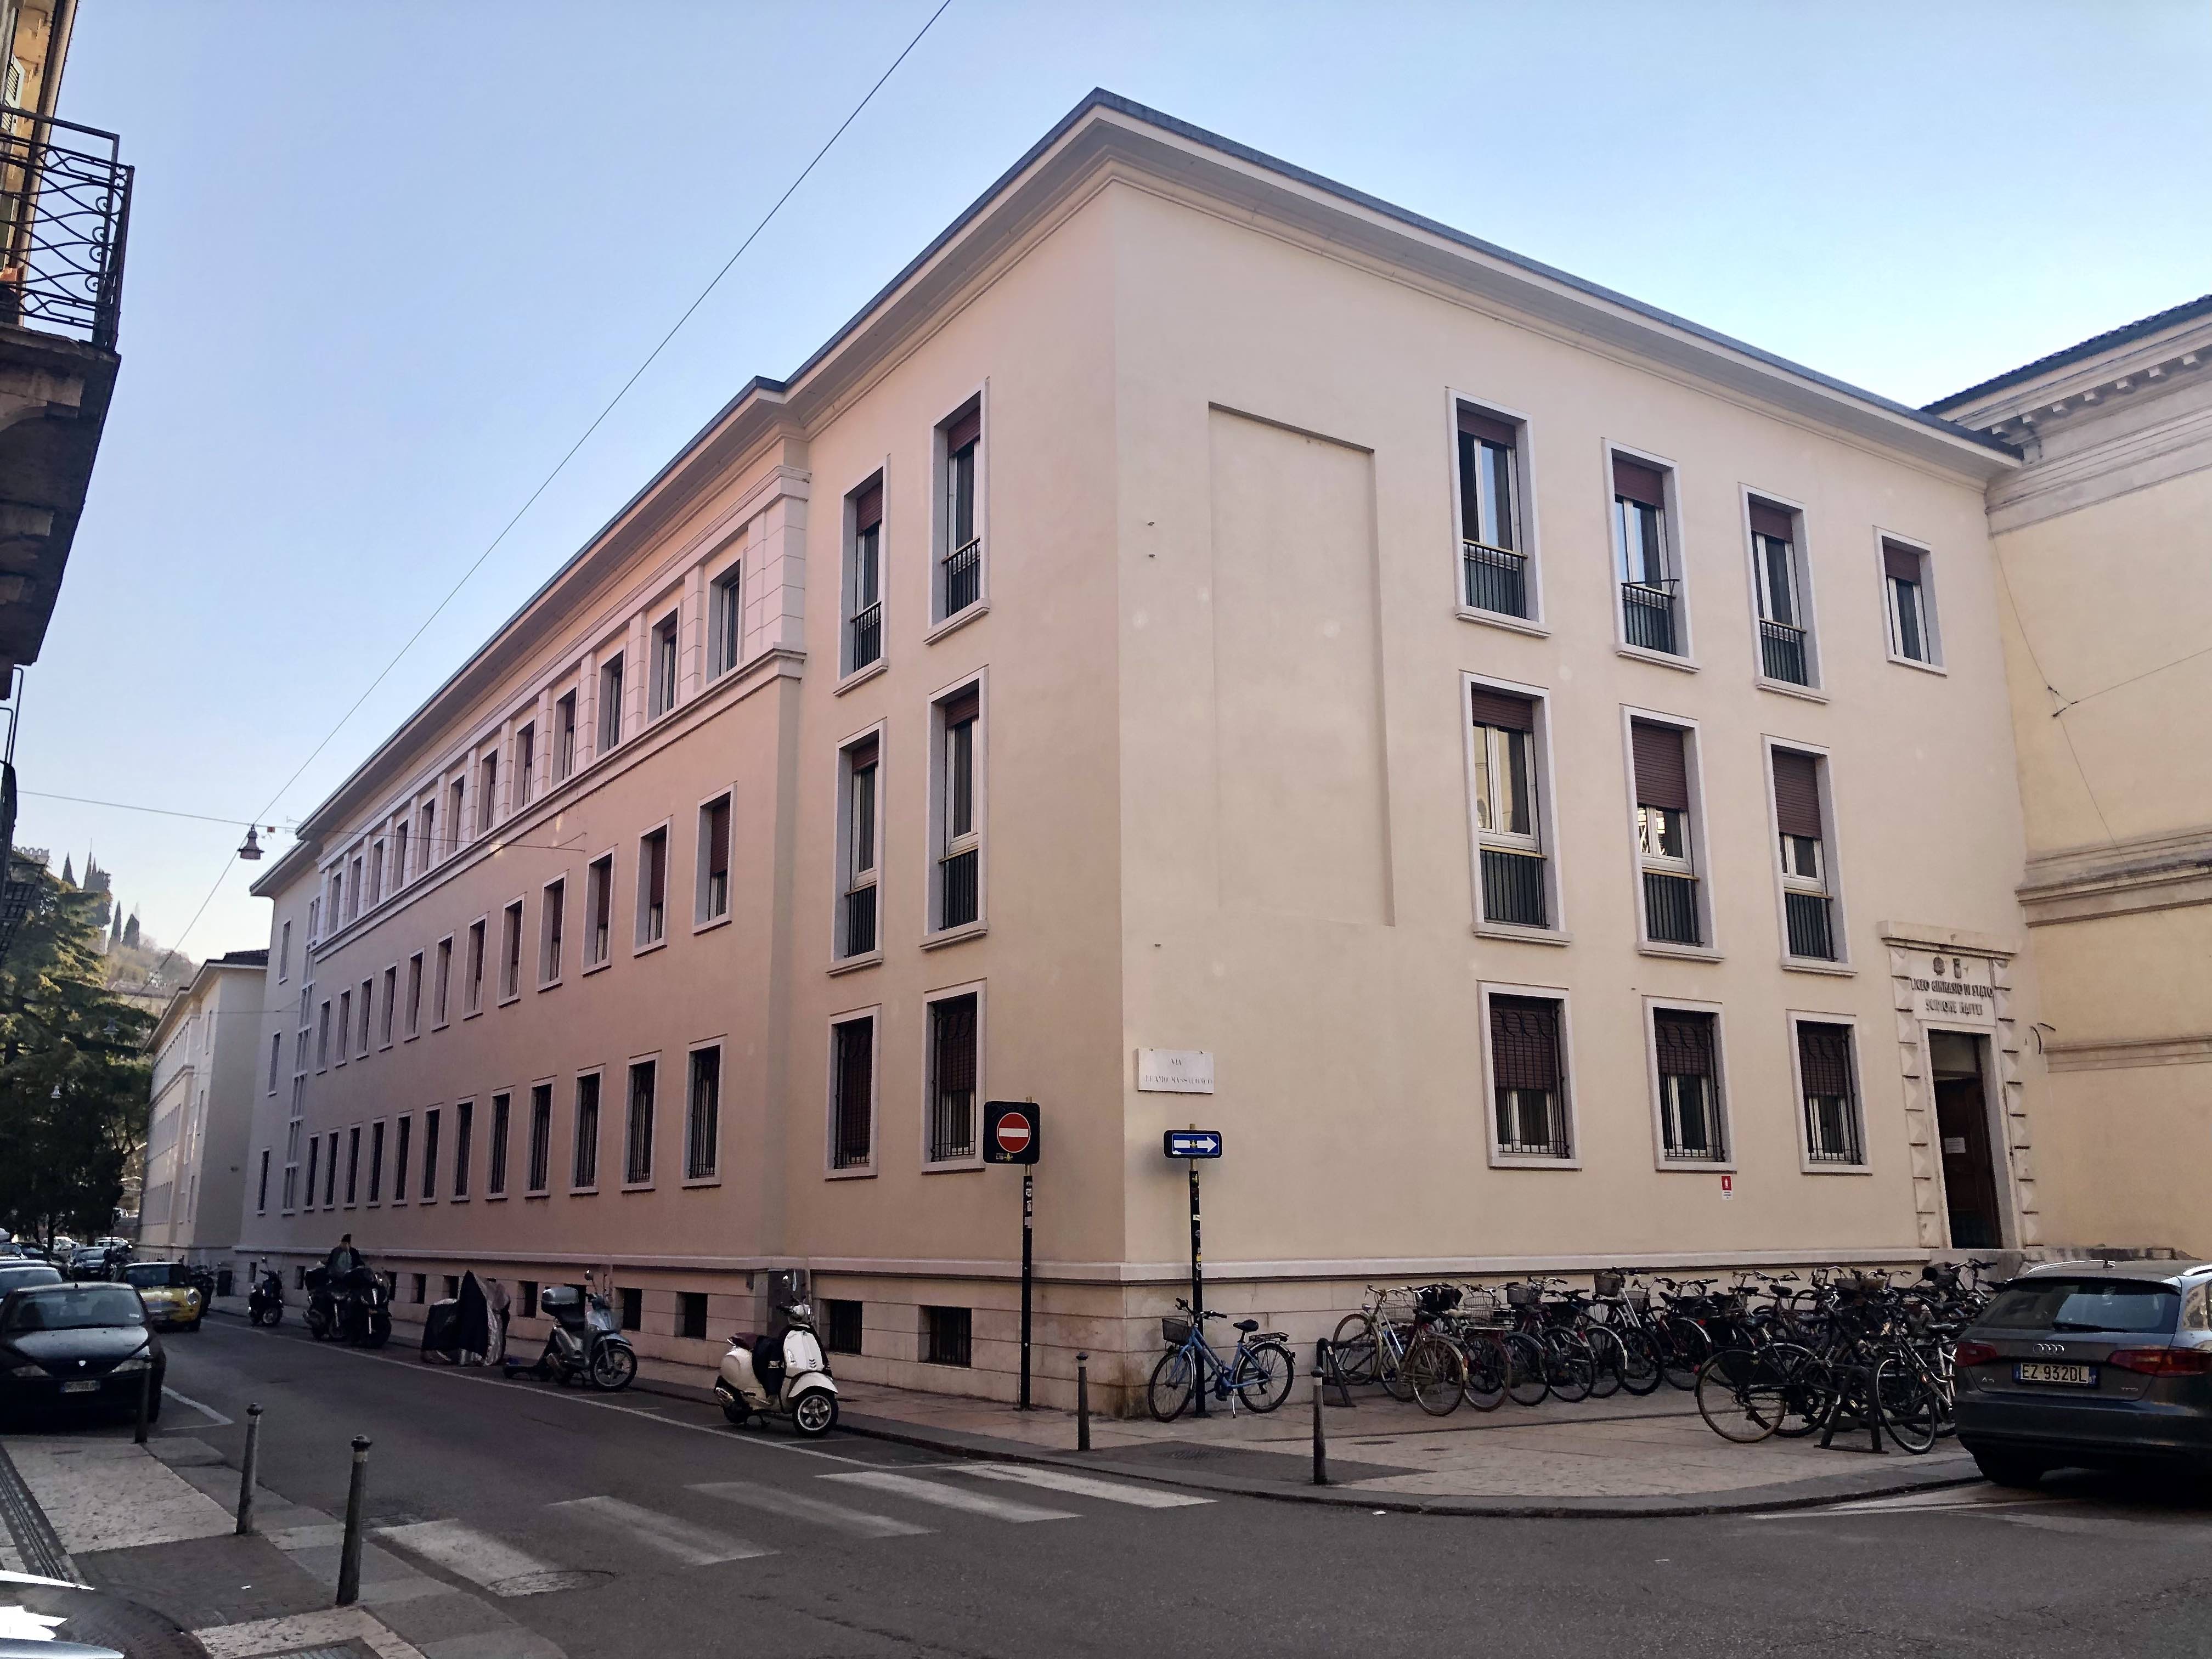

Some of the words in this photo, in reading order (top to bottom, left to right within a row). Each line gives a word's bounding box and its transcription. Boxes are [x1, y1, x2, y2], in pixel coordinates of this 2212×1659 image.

[1910, 978, 1930, 991] LICEO
[1931, 980, 1963, 995] GINNASIO
[1963, 983, 1971, 996] DI
[1972, 985, 1993, 998] STATO
[1171, 1058, 1182, 1066] VIA
[2022, 1364, 2038, 1379] EZ
[2043, 1365, 2087, 1382] 932DL
